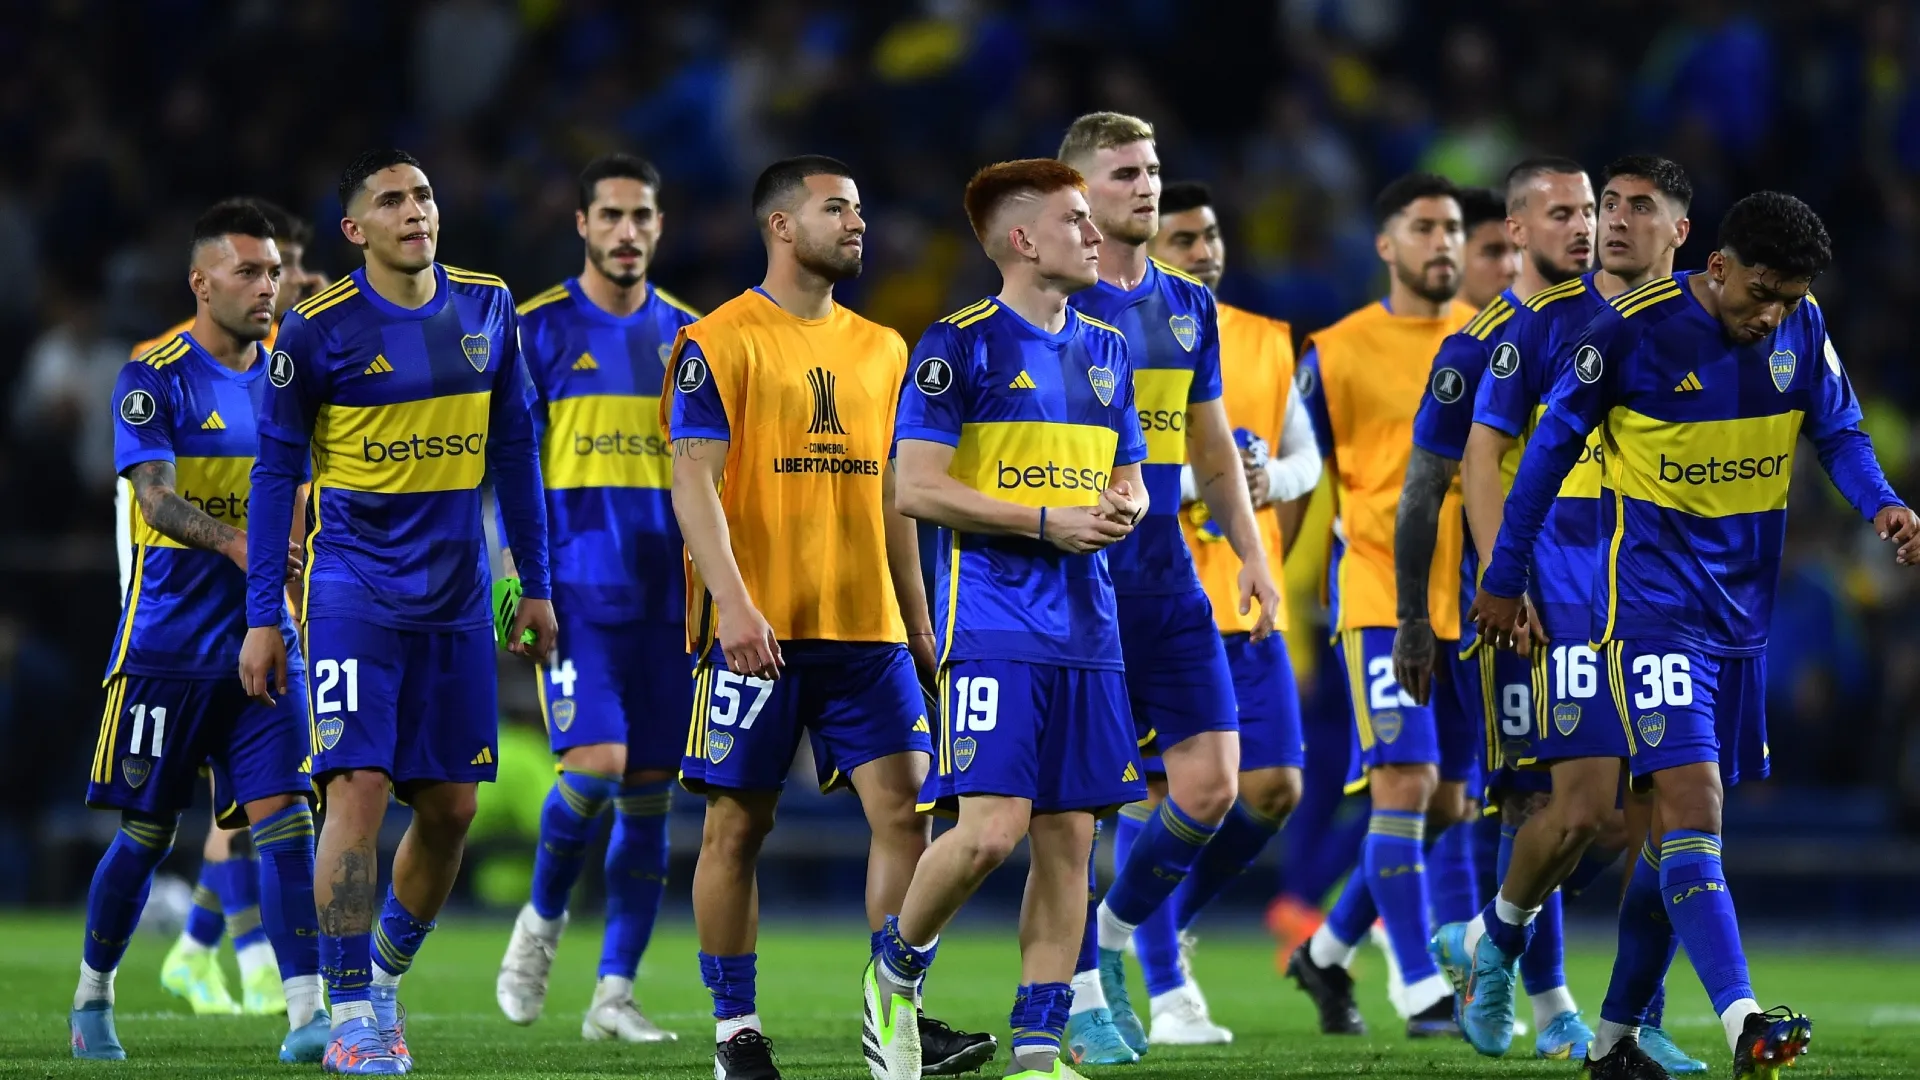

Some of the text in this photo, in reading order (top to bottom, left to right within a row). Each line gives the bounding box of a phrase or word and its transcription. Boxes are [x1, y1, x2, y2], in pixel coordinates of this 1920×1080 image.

[467, 347, 487, 355] CABJ
[1773, 364, 1792, 374] CABJ
[1093, 378, 1112, 389] CABJ
[773, 457, 879, 476] LIBERTADORES
[809, 442, 846, 455] CONMEBOL
[315, 658, 358, 714] 21
[550, 649, 578, 697] 4
[1368, 655, 1420, 710] 2
[1551, 645, 1597, 700] 16
[1632, 653, 1693, 710] 36
[710, 669, 775, 730] 57
[955, 676, 999, 732] 19
[1502, 684, 1531, 736] 9
[129, 704, 167, 758] 11
[321, 728, 339, 736] CABJ
[709, 741, 729, 750] CABJ
[1643, 723, 1663, 734] CABJ
